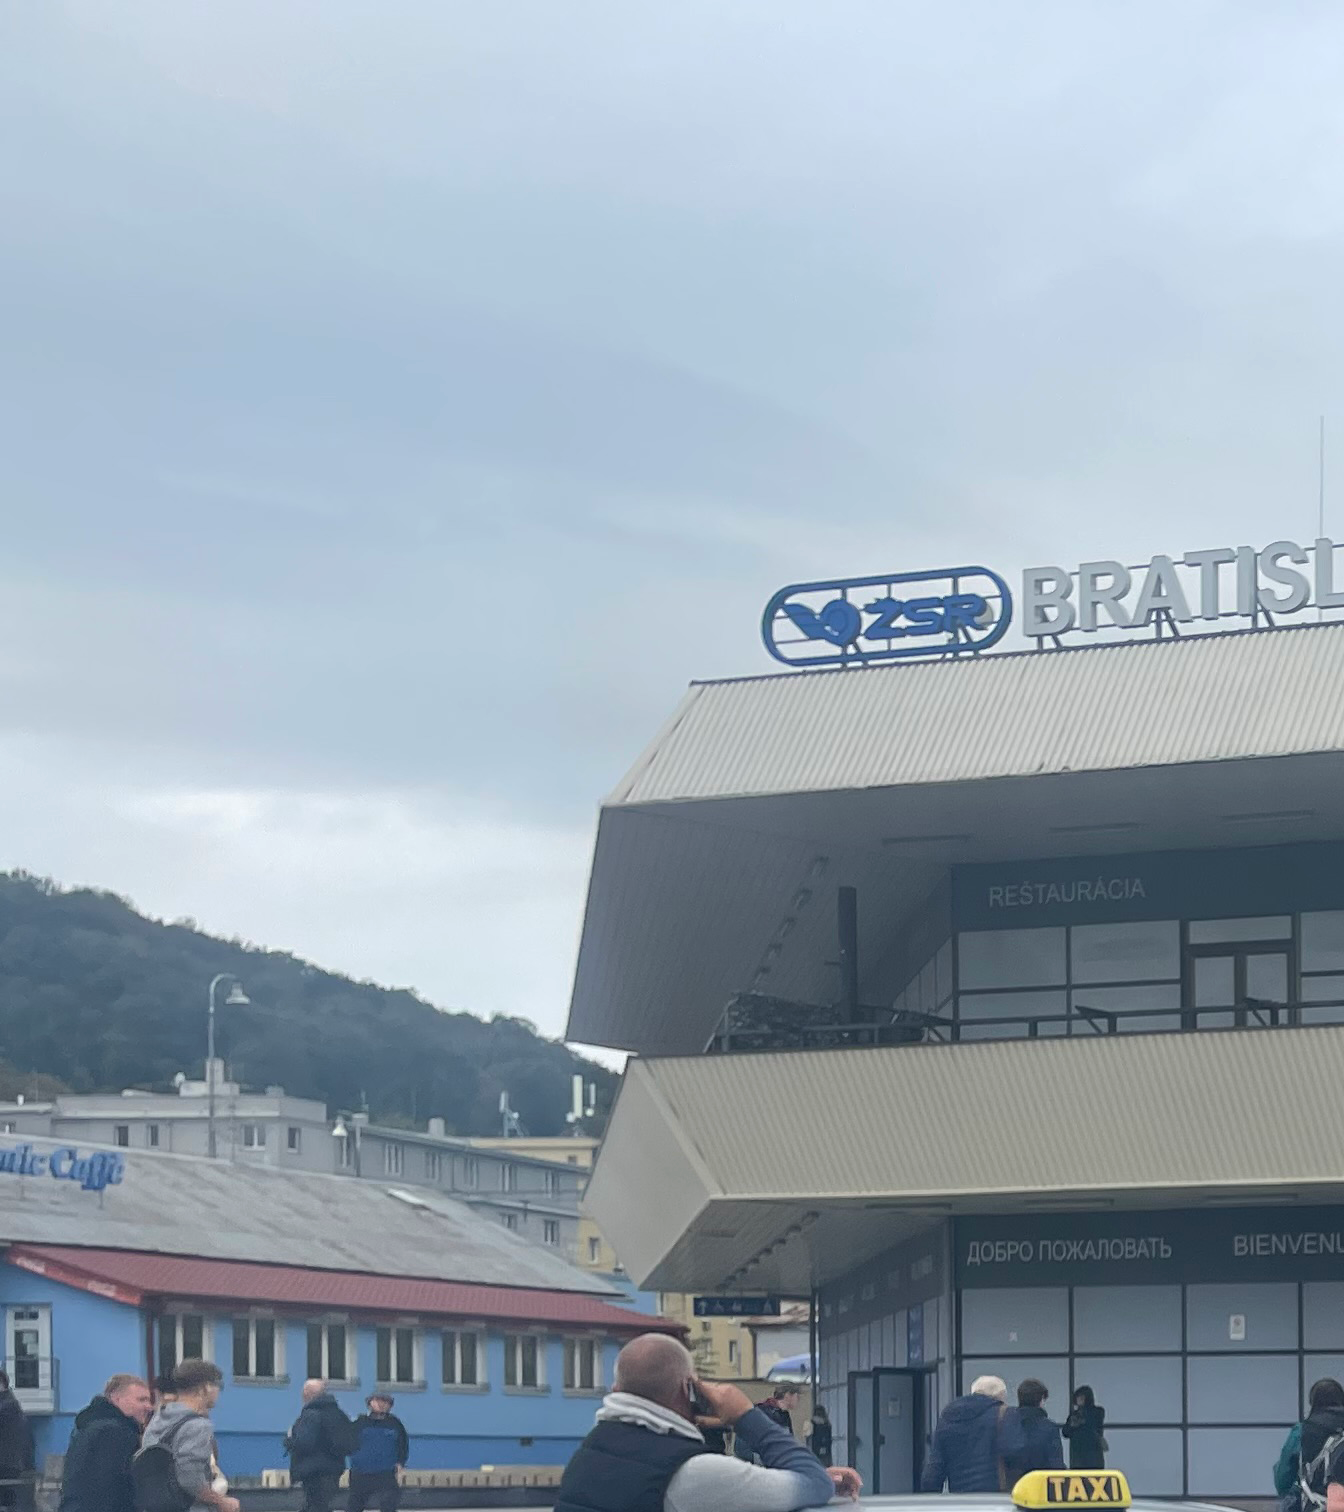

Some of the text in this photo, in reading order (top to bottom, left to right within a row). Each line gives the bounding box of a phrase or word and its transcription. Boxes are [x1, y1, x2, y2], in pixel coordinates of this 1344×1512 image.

[988, 875, 1147, 908] REŠTAURÁCIA
[967, 1236, 1173, 1266] ДОБРО ПОЖАЛОВАТЬ
[1049, 1476, 1120, 1502] TAXI
